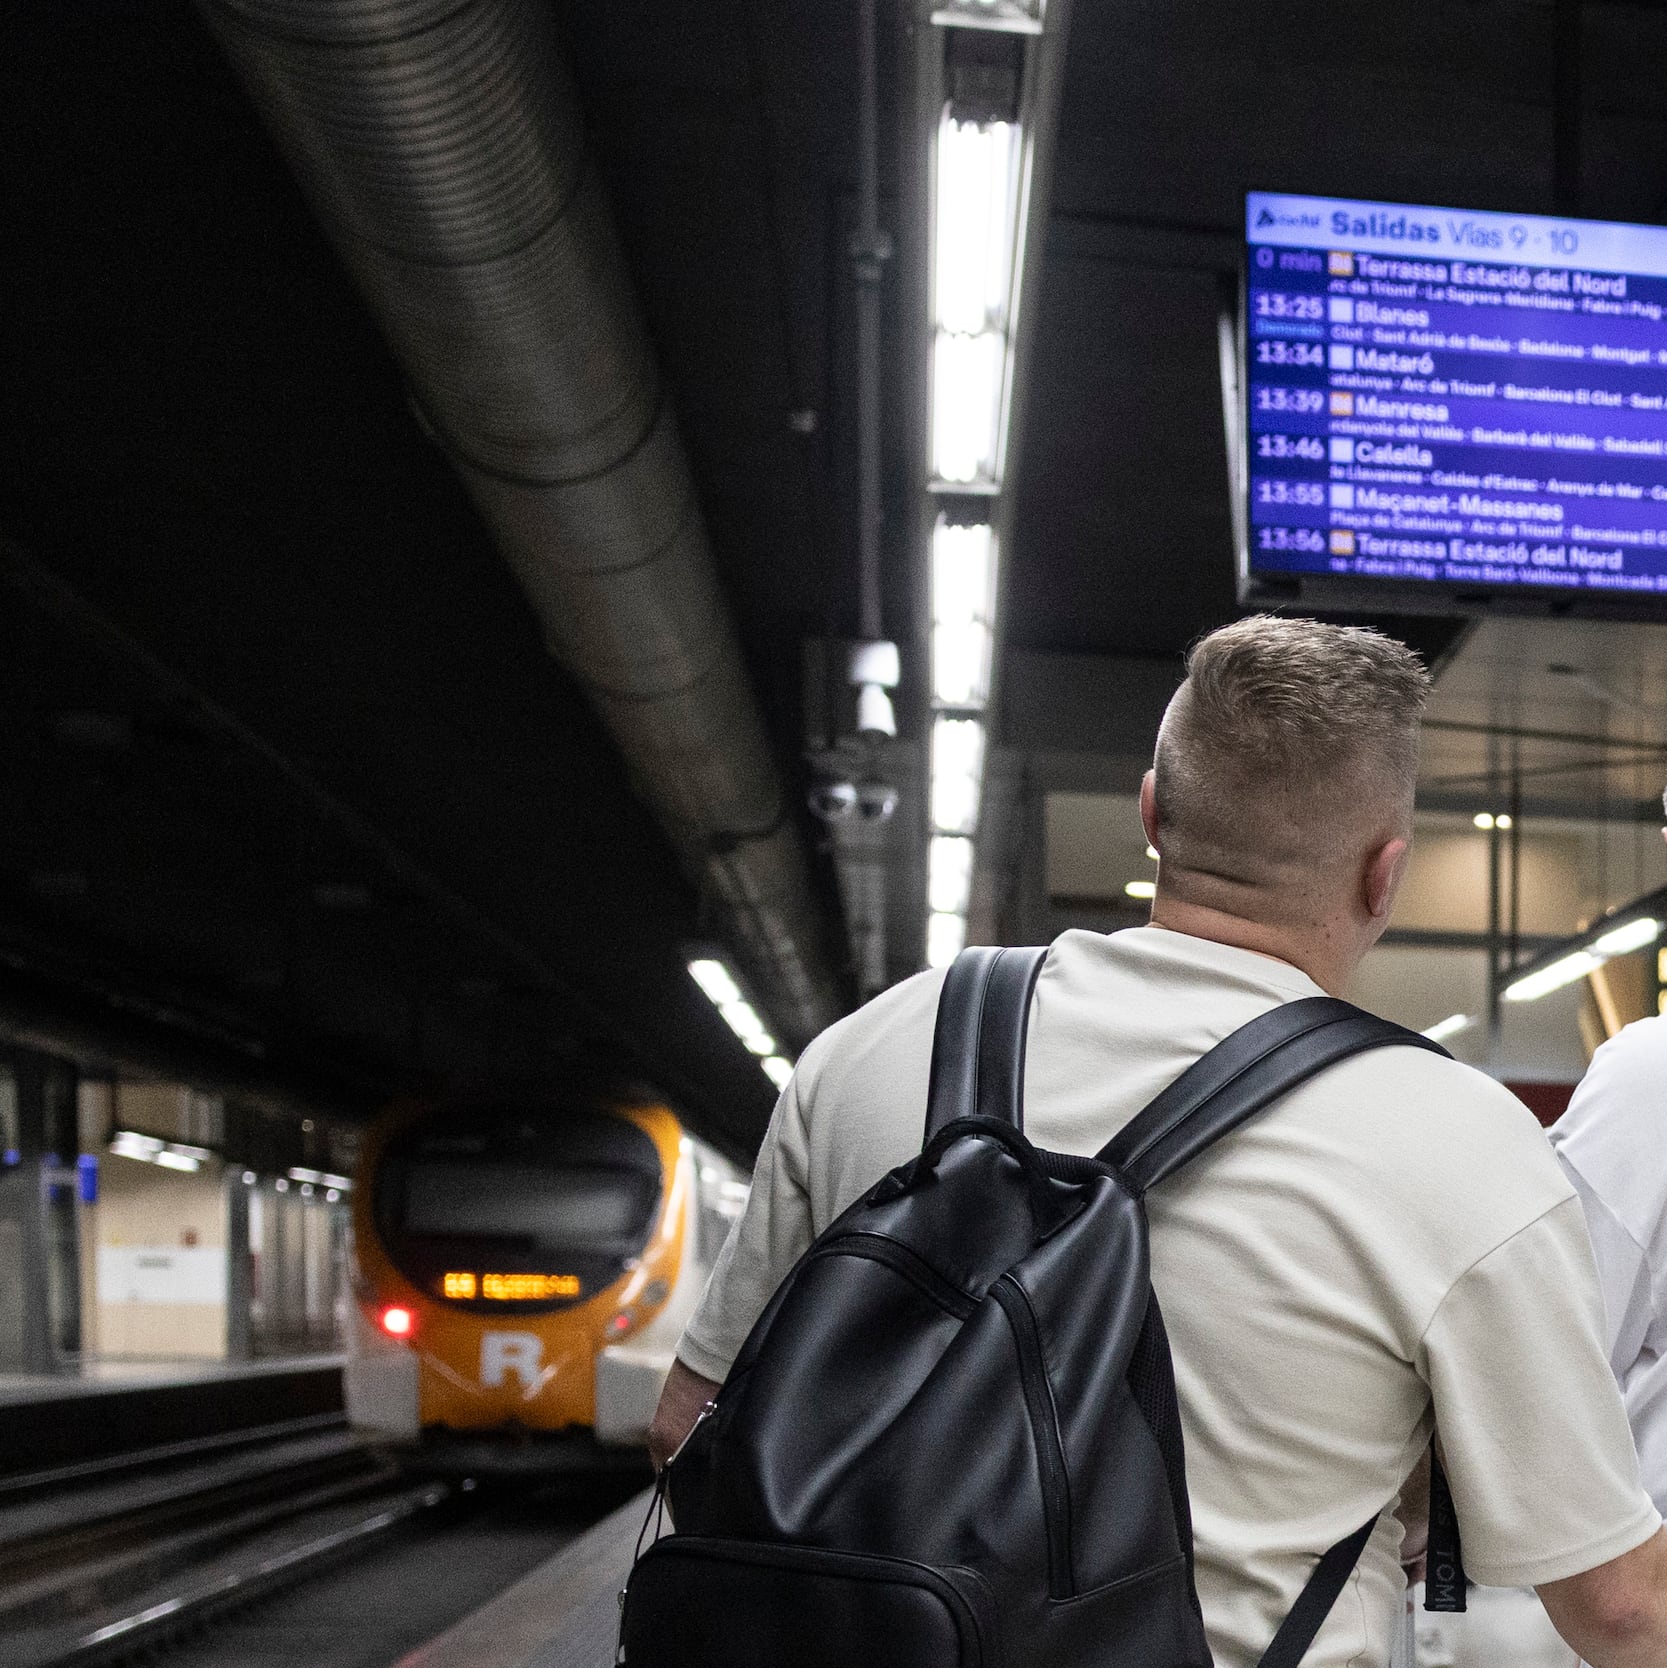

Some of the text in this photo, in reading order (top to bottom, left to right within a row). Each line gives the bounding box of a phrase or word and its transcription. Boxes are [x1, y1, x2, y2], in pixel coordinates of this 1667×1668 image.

[1330, 209, 1441, 242] Salidas
[1507, 224, 1529, 250] 9
[1550, 228, 1579, 255] 10
[1355, 254, 1448, 282] Terrassa
[1450, 262, 1532, 290] Estació
[1537, 267, 1569, 293] del
[1573, 270, 1627, 297] Nord
[1257, 294, 1323, 318] 13:25
[1356, 301, 1430, 327] Blanes
[1257, 341, 1324, 366] 13:34
[1356, 348, 1434, 375] Mataró
[1257, 388, 1324, 413] 13:39
[1356, 395, 1448, 422] Manresa
[1257, 434, 1325, 460] 13:46
[1356, 441, 1433, 468] Calella
[1258, 527, 1325, 552] 13:56
[1356, 533, 1447, 560] Terrassa
[1449, 538, 1529, 564] Estació
[1531, 544, 1566, 567] del
[1569, 547, 1623, 570] Nord
[480, 1331, 543, 1388] R
